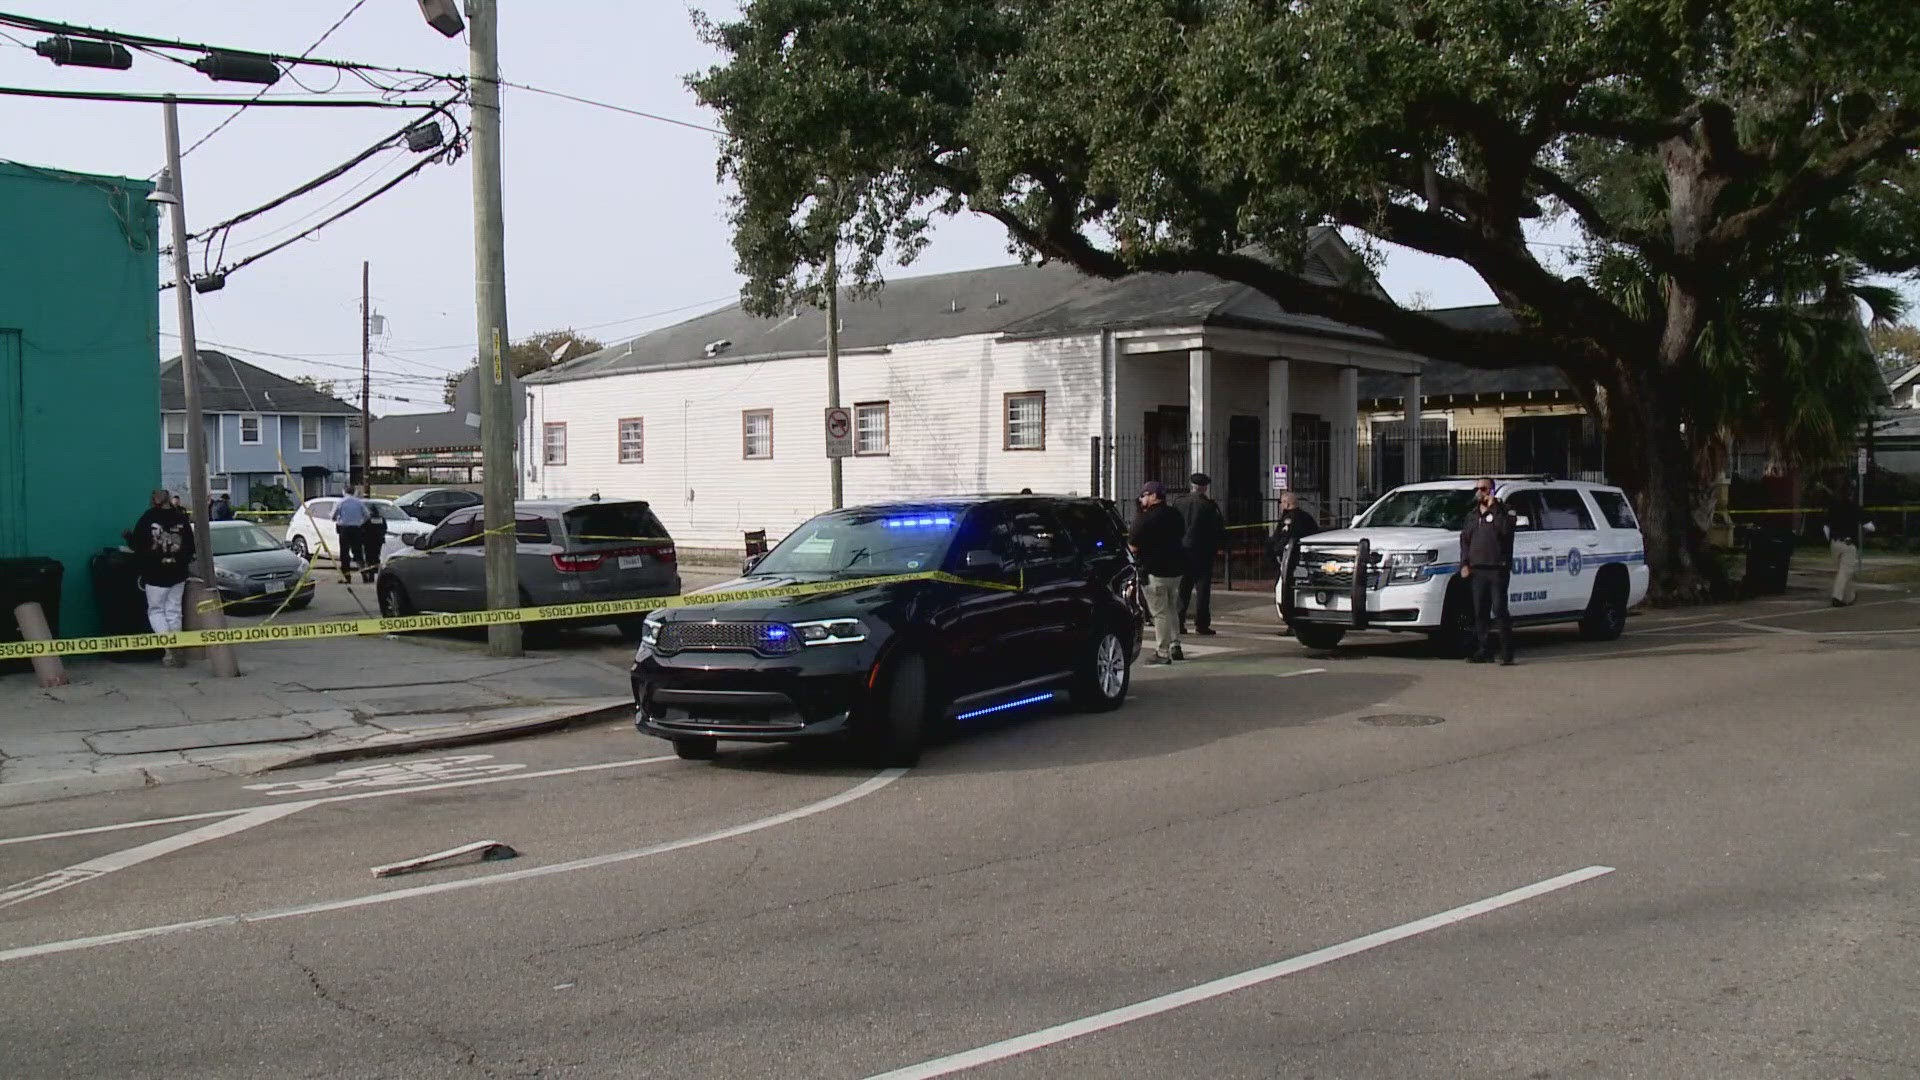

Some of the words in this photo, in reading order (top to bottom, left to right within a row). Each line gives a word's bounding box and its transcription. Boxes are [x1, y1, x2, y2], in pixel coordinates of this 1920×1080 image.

[1512, 556, 1553, 574] OLICE
[716, 593, 734, 602] NOT
[735, 591, 749, 601] DO
[750, 589, 769, 599] LINE
[769, 587, 800, 597] POLICE
[633, 599, 667, 610] POLICE
[683, 594, 715, 606] CROSS
[538, 606, 573, 618] CROSS
[575, 604, 595, 615] NOT
[596, 603, 610, 613] DO
[611, 602, 631, 612] LINE
[442, 615, 458, 626] DO
[461, 613, 483, 624] LINE
[485, 610, 521, 621] POLICE
[379, 619, 417, 630] CROSS
[419, 616, 441, 627] NOT
[271, 627, 289, 638] DO
[291, 625, 316, 636] LINE
[319, 622, 358, 634] POLICE
[200, 630, 243, 642] CROSS
[245, 628, 269, 640] NOT
[78, 639, 98, 651] DO
[101, 637, 129, 650] LINE
[130, 634, 177, 647] POLICE
[0, 642, 45, 656] CROSS
[49, 641, 75, 653] NOT
